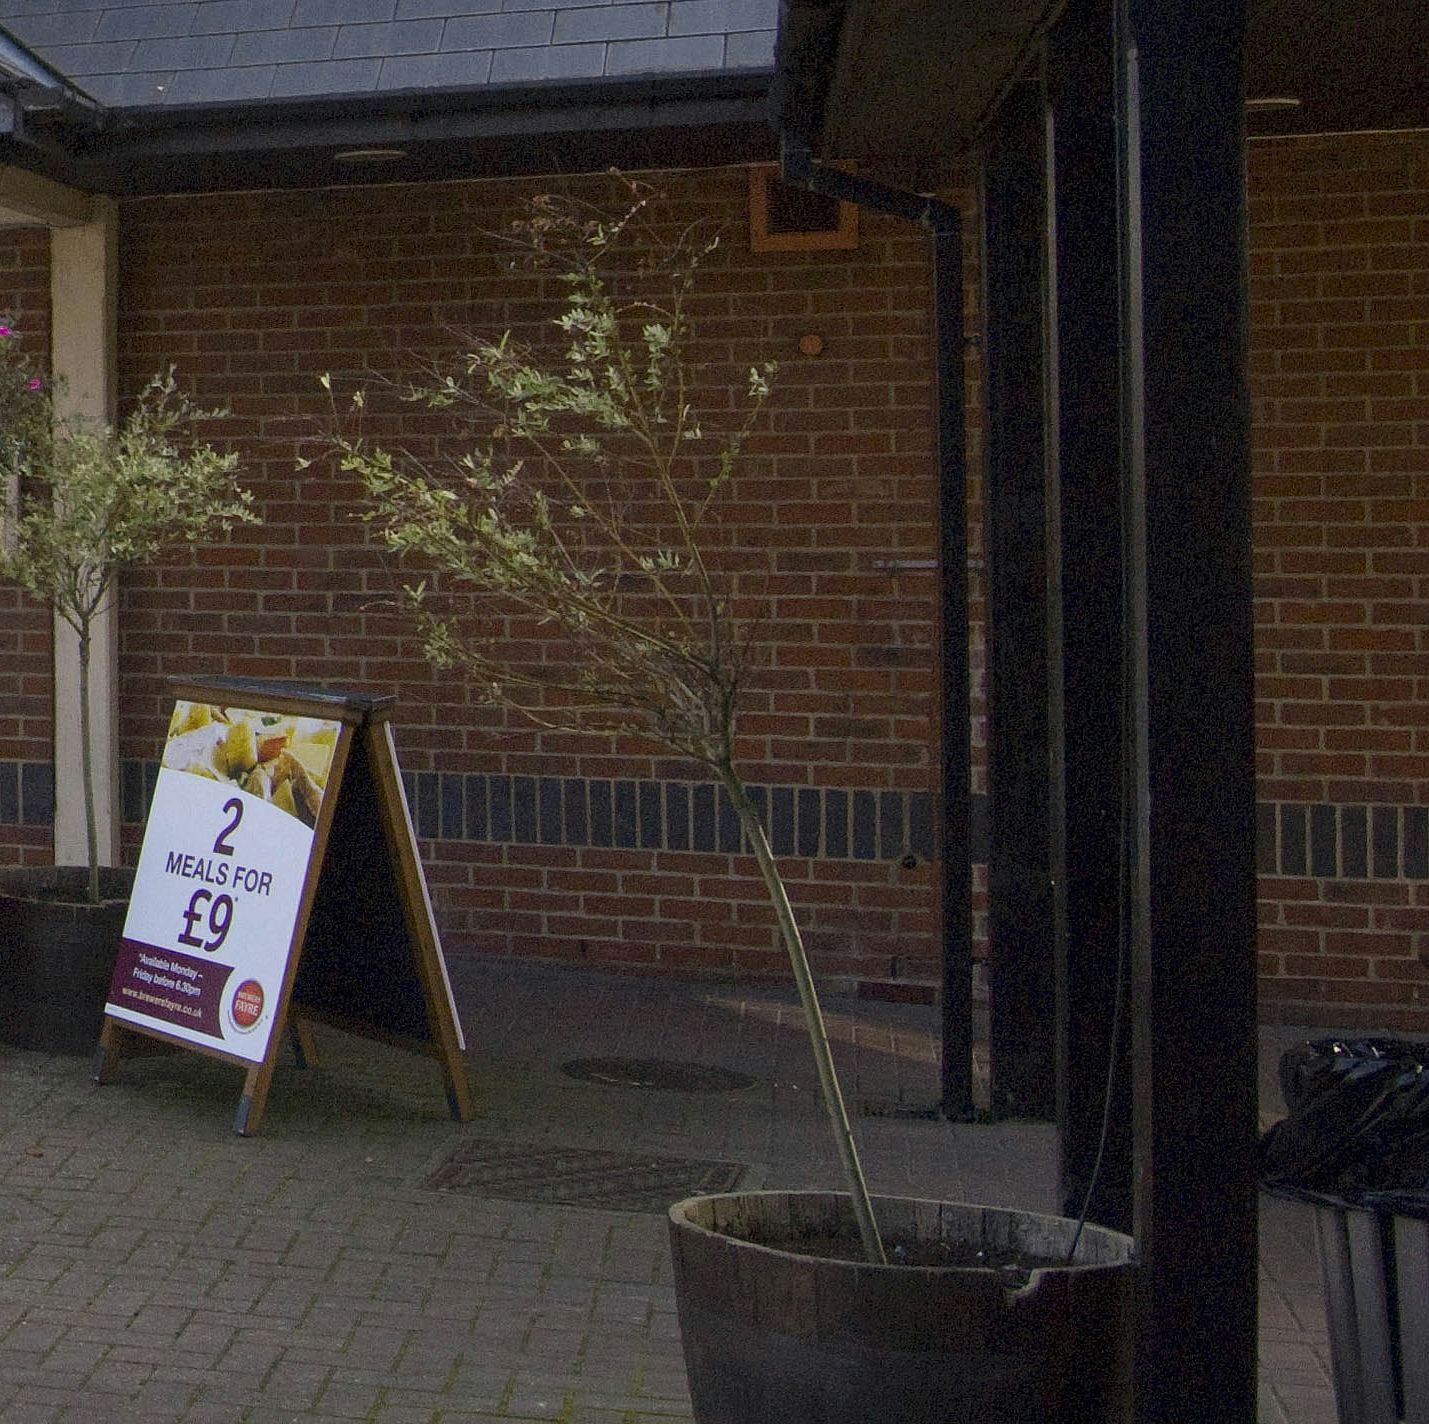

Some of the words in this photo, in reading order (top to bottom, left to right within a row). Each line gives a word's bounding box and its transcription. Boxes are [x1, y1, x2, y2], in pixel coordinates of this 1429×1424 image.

[213, 798, 244, 856] 2
[165, 851, 229, 886] MEALS
[233, 866, 273, 896] FOR
[133, 967, 152, 984] Friday
[153, 973, 175, 989] before
[170, 962, 198, 980] Monday
[235, 999, 259, 1017] FAYRE
